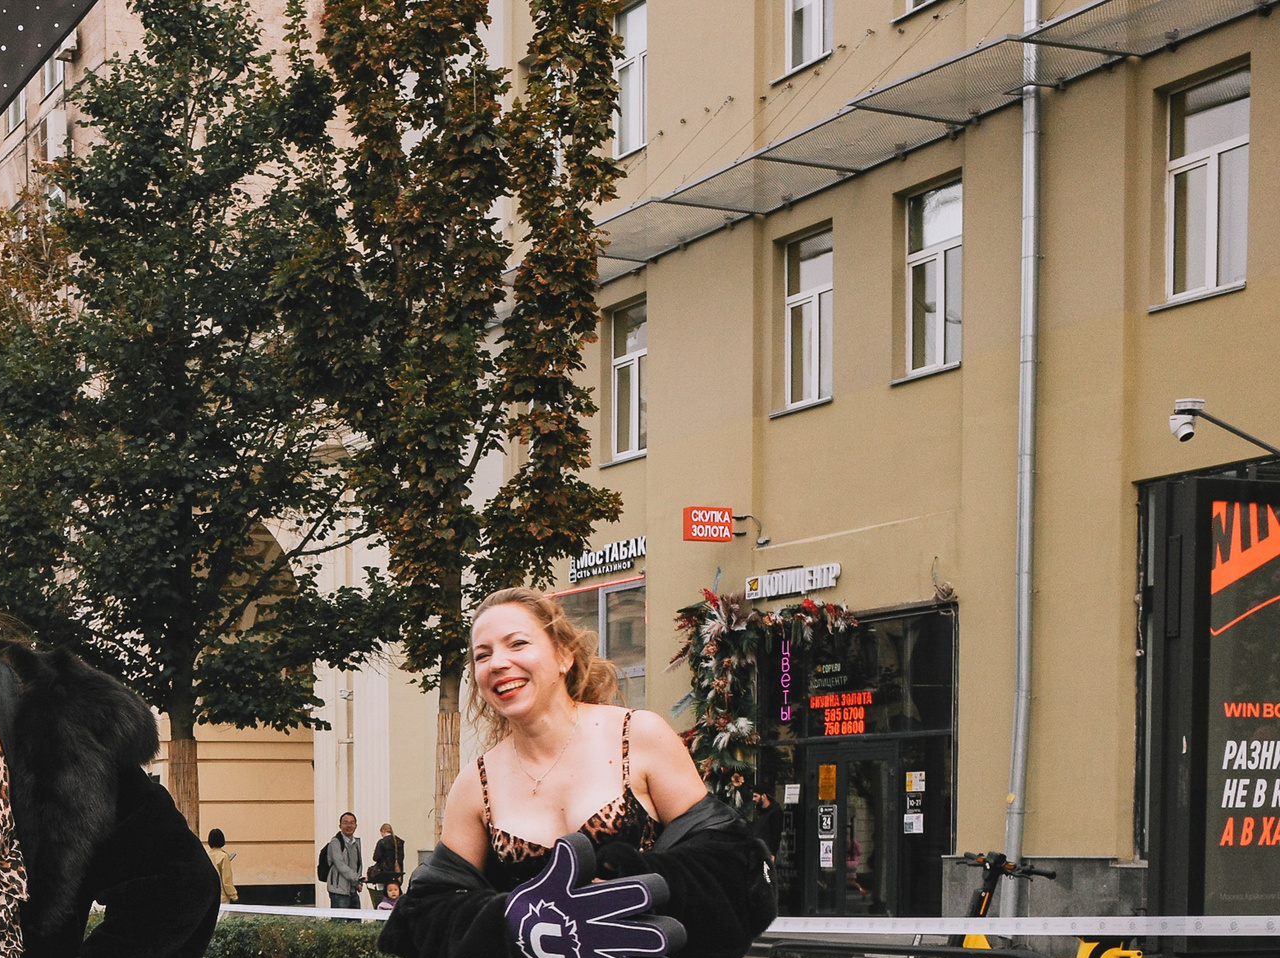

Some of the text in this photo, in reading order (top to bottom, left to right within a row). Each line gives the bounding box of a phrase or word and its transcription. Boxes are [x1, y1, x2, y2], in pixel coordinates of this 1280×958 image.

[691, 509, 731, 524] СКУПКА
[691, 524, 731, 538] ЗОЛОТА
[591, 560, 631, 576] МАГАЗИНОВ
[762, 563, 841, 597] КОПИЦЕНТР
[810, 691, 872, 709] СКУПКА ЗОЛОТА
[843, 706, 865, 721] 6700
[1223, 702, 1260, 718] WIN
[824, 720, 864, 736] 750 8600
[1221, 778, 1250, 808] НЕ
[1252, 778, 1268, 808] В
[1219, 816, 1234, 846] А
[1240, 816, 1255, 846] В
